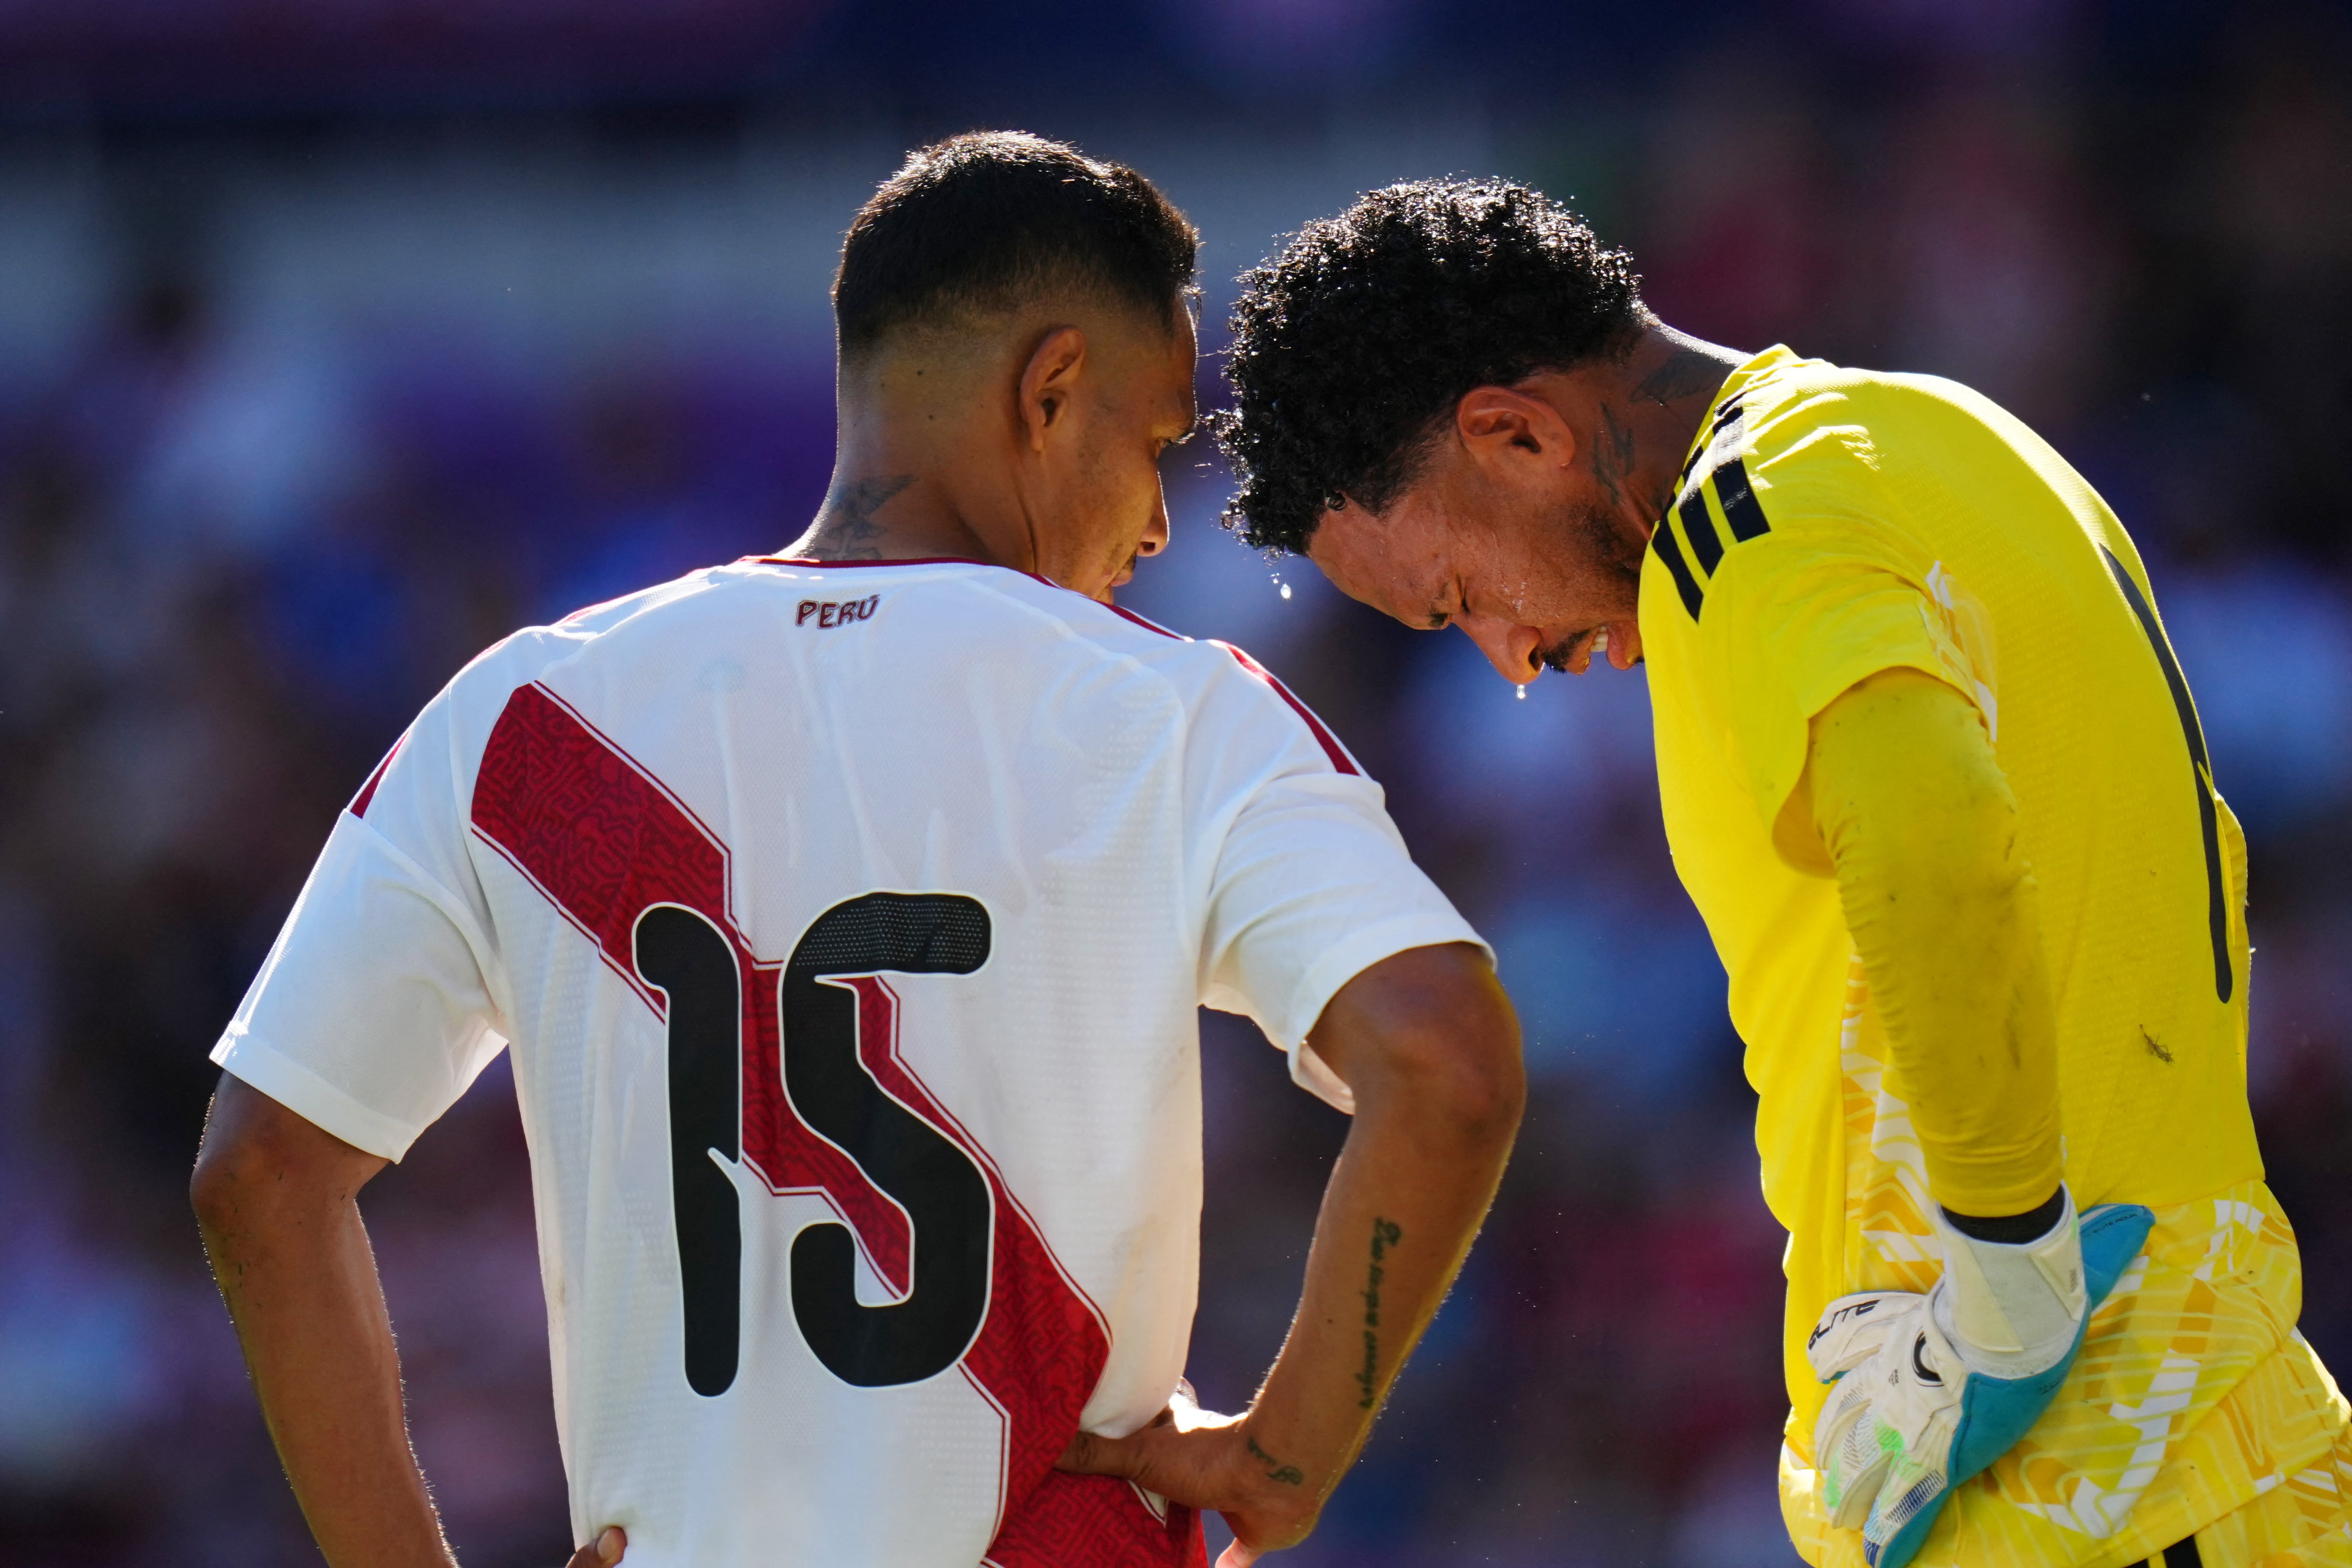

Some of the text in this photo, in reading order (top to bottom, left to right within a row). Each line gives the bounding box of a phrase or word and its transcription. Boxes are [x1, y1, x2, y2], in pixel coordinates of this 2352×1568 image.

[795, 594, 881, 629] PERÚ
[631, 889, 995, 1400] 15
[1808, 1299, 1882, 1351] ELITE
